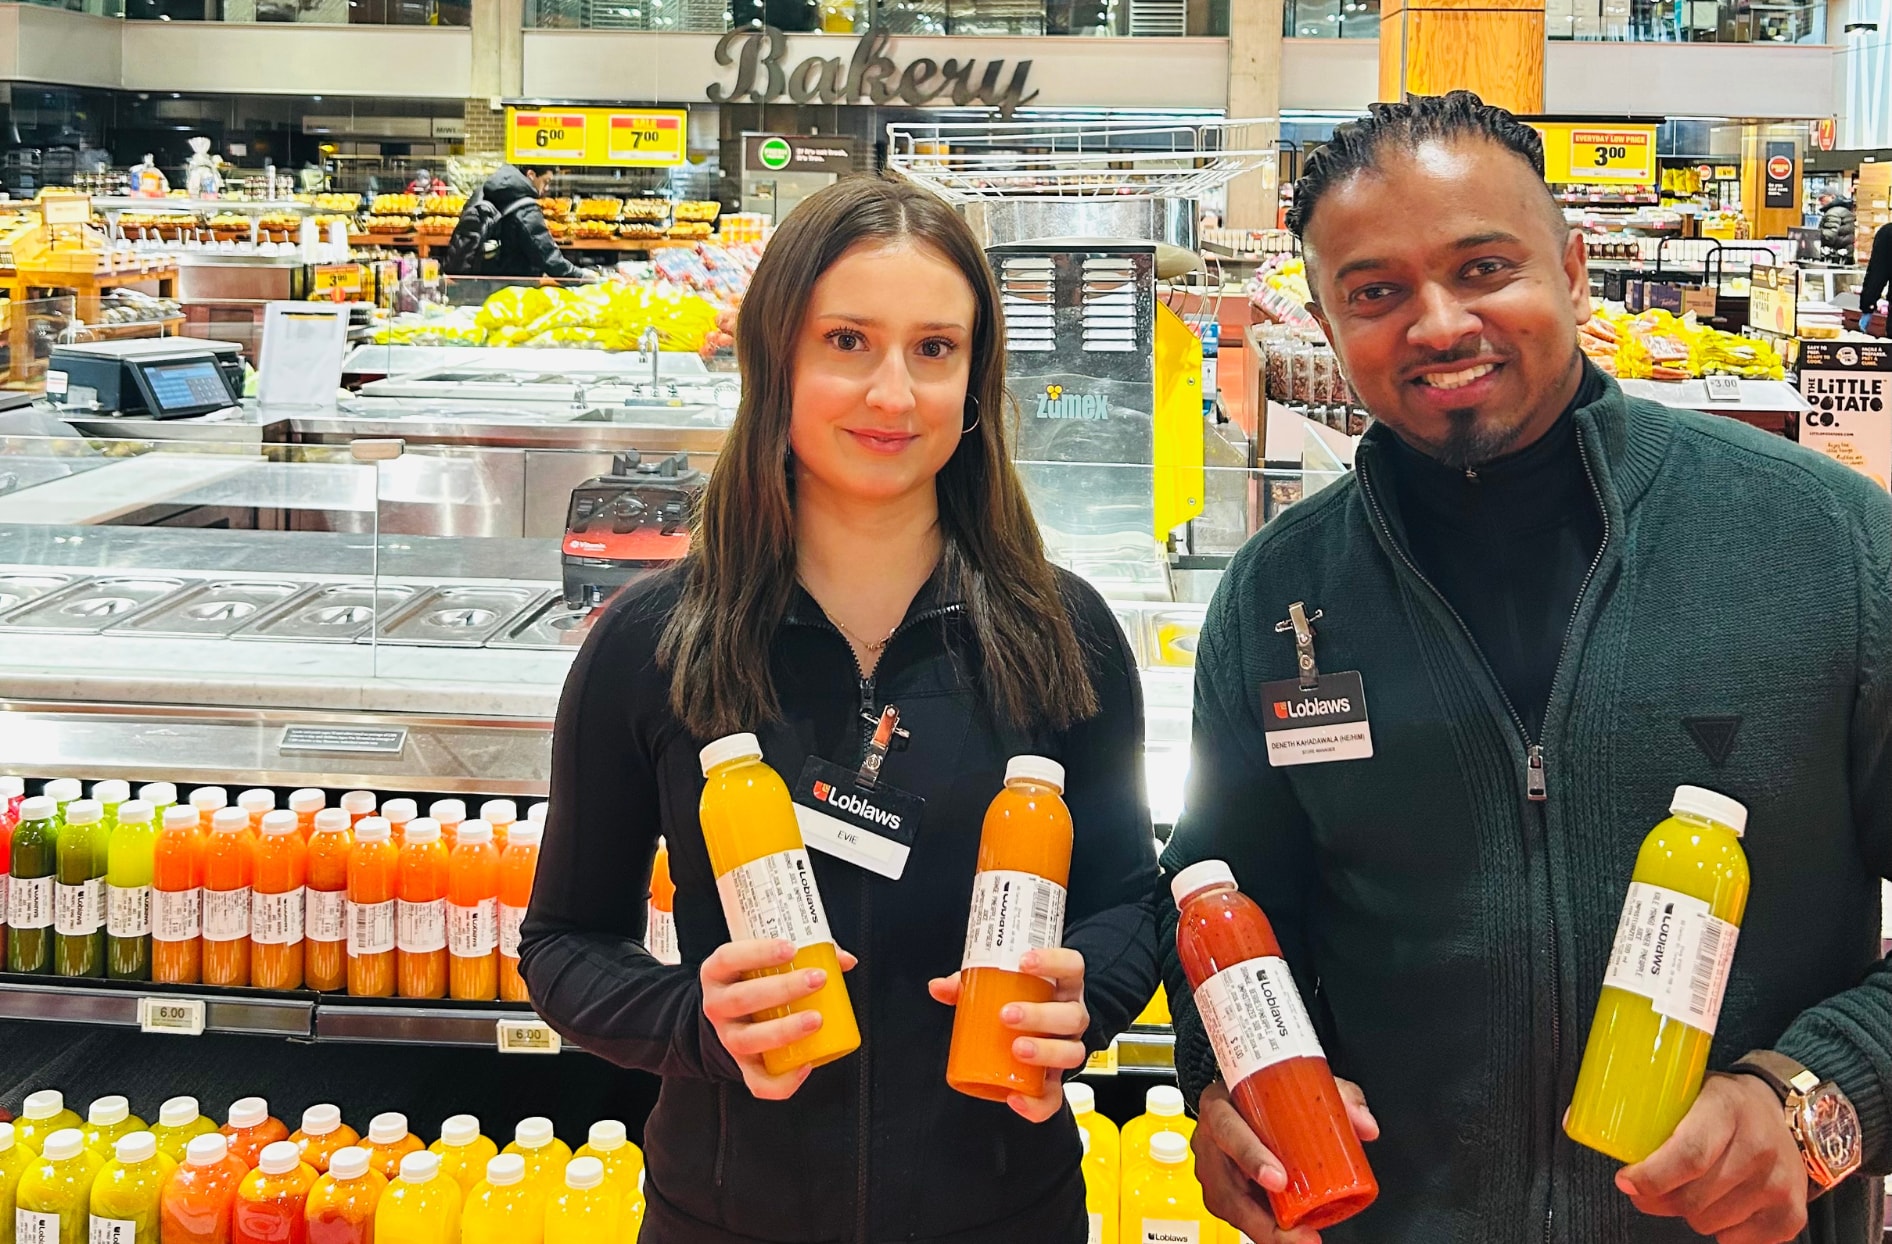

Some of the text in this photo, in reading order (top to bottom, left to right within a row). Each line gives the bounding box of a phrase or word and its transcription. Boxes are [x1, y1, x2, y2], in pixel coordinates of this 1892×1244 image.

[705, 23, 1040, 122] Bakery
[1575, 134, 1646, 144] EVERYDAY LOW PRICE
[1036, 392, 1109, 421] zumex
[1807, 395, 1883, 412] POTATO
[1805, 411, 1840, 428] CO.
[1287, 697, 1351, 718] Loblaws
[828, 786, 901, 831] Loblaws
[837, 830, 857, 845] EVIE
[799, 871, 819, 924] Loblaws
[1647, 907, 1658, 926] MANGO
[160, 1006, 185, 1019] 6.00
[1261, 980, 1288, 1038] Loblaws
[516, 1028, 541, 1040] 6.00
[1155, 1232, 1188, 1243] Loblaws
